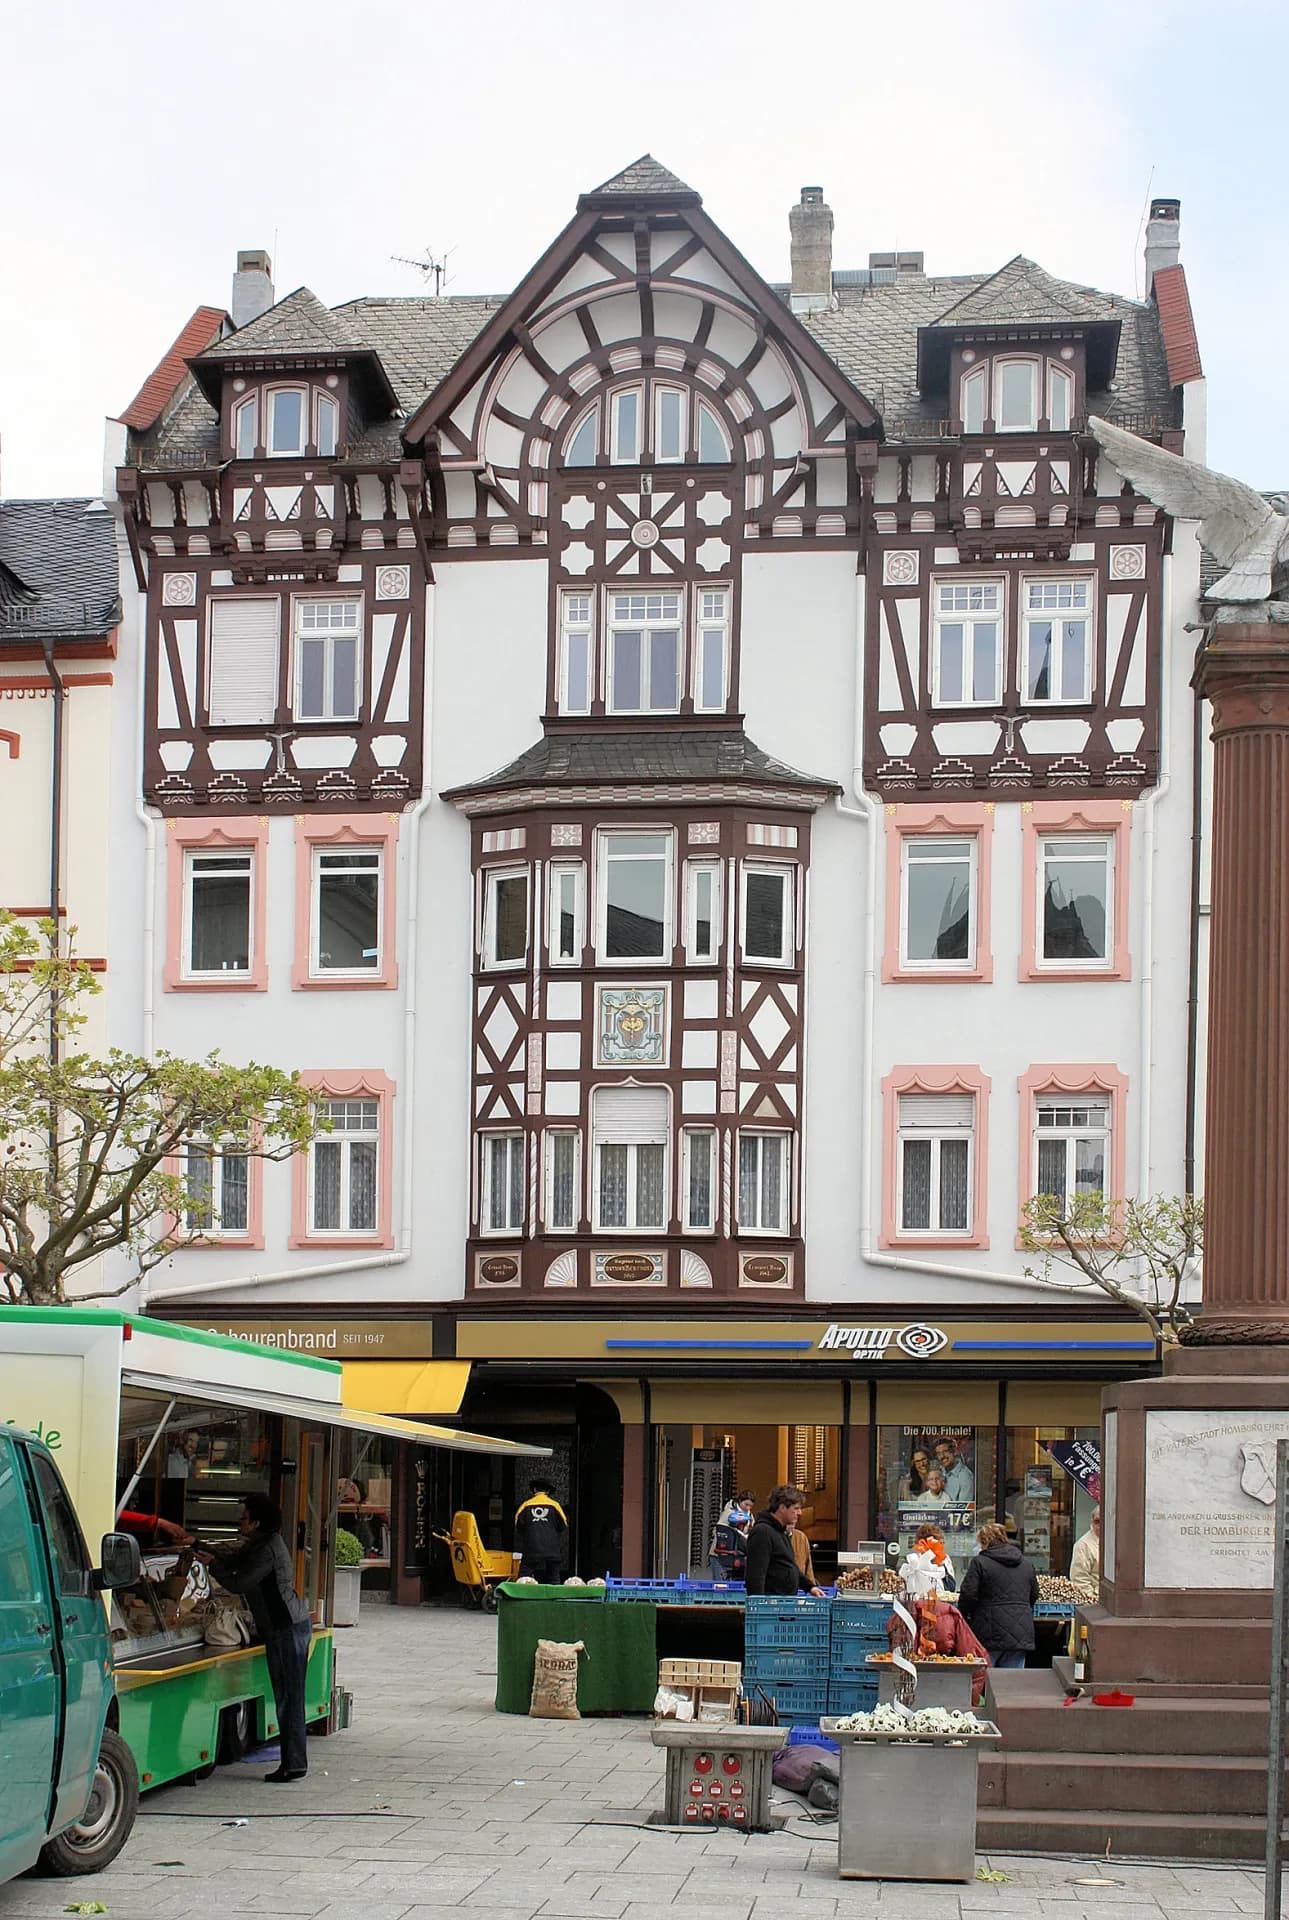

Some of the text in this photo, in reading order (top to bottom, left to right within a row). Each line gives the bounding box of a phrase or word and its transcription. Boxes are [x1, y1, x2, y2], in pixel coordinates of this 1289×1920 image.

[207, 1328, 385, 1349] heurenbrand SEIT 1947
[818, 1324, 894, 1349] APOLLO
[852, 1349, 886, 1360] OPTIK
[903, 1425, 972, 1436] Die 700. Filiale!
[1166, 1429, 1220, 1453] VATERSTADT
[1221, 1424, 1263, 1436] HOMBURG
[1263, 1423, 1284, 1432] EHRT
[1072, 1441, 1101, 1473] Fassunge
[1073, 1459, 1092, 1479] 7€
[947, 1512, 970, 1526] 17€
[1167, 1512, 1205, 1521] ANDENKEN
[1180, 1526, 1271, 1536] DER HOMBURGER
[1255, 1549, 1269, 1557] AM
